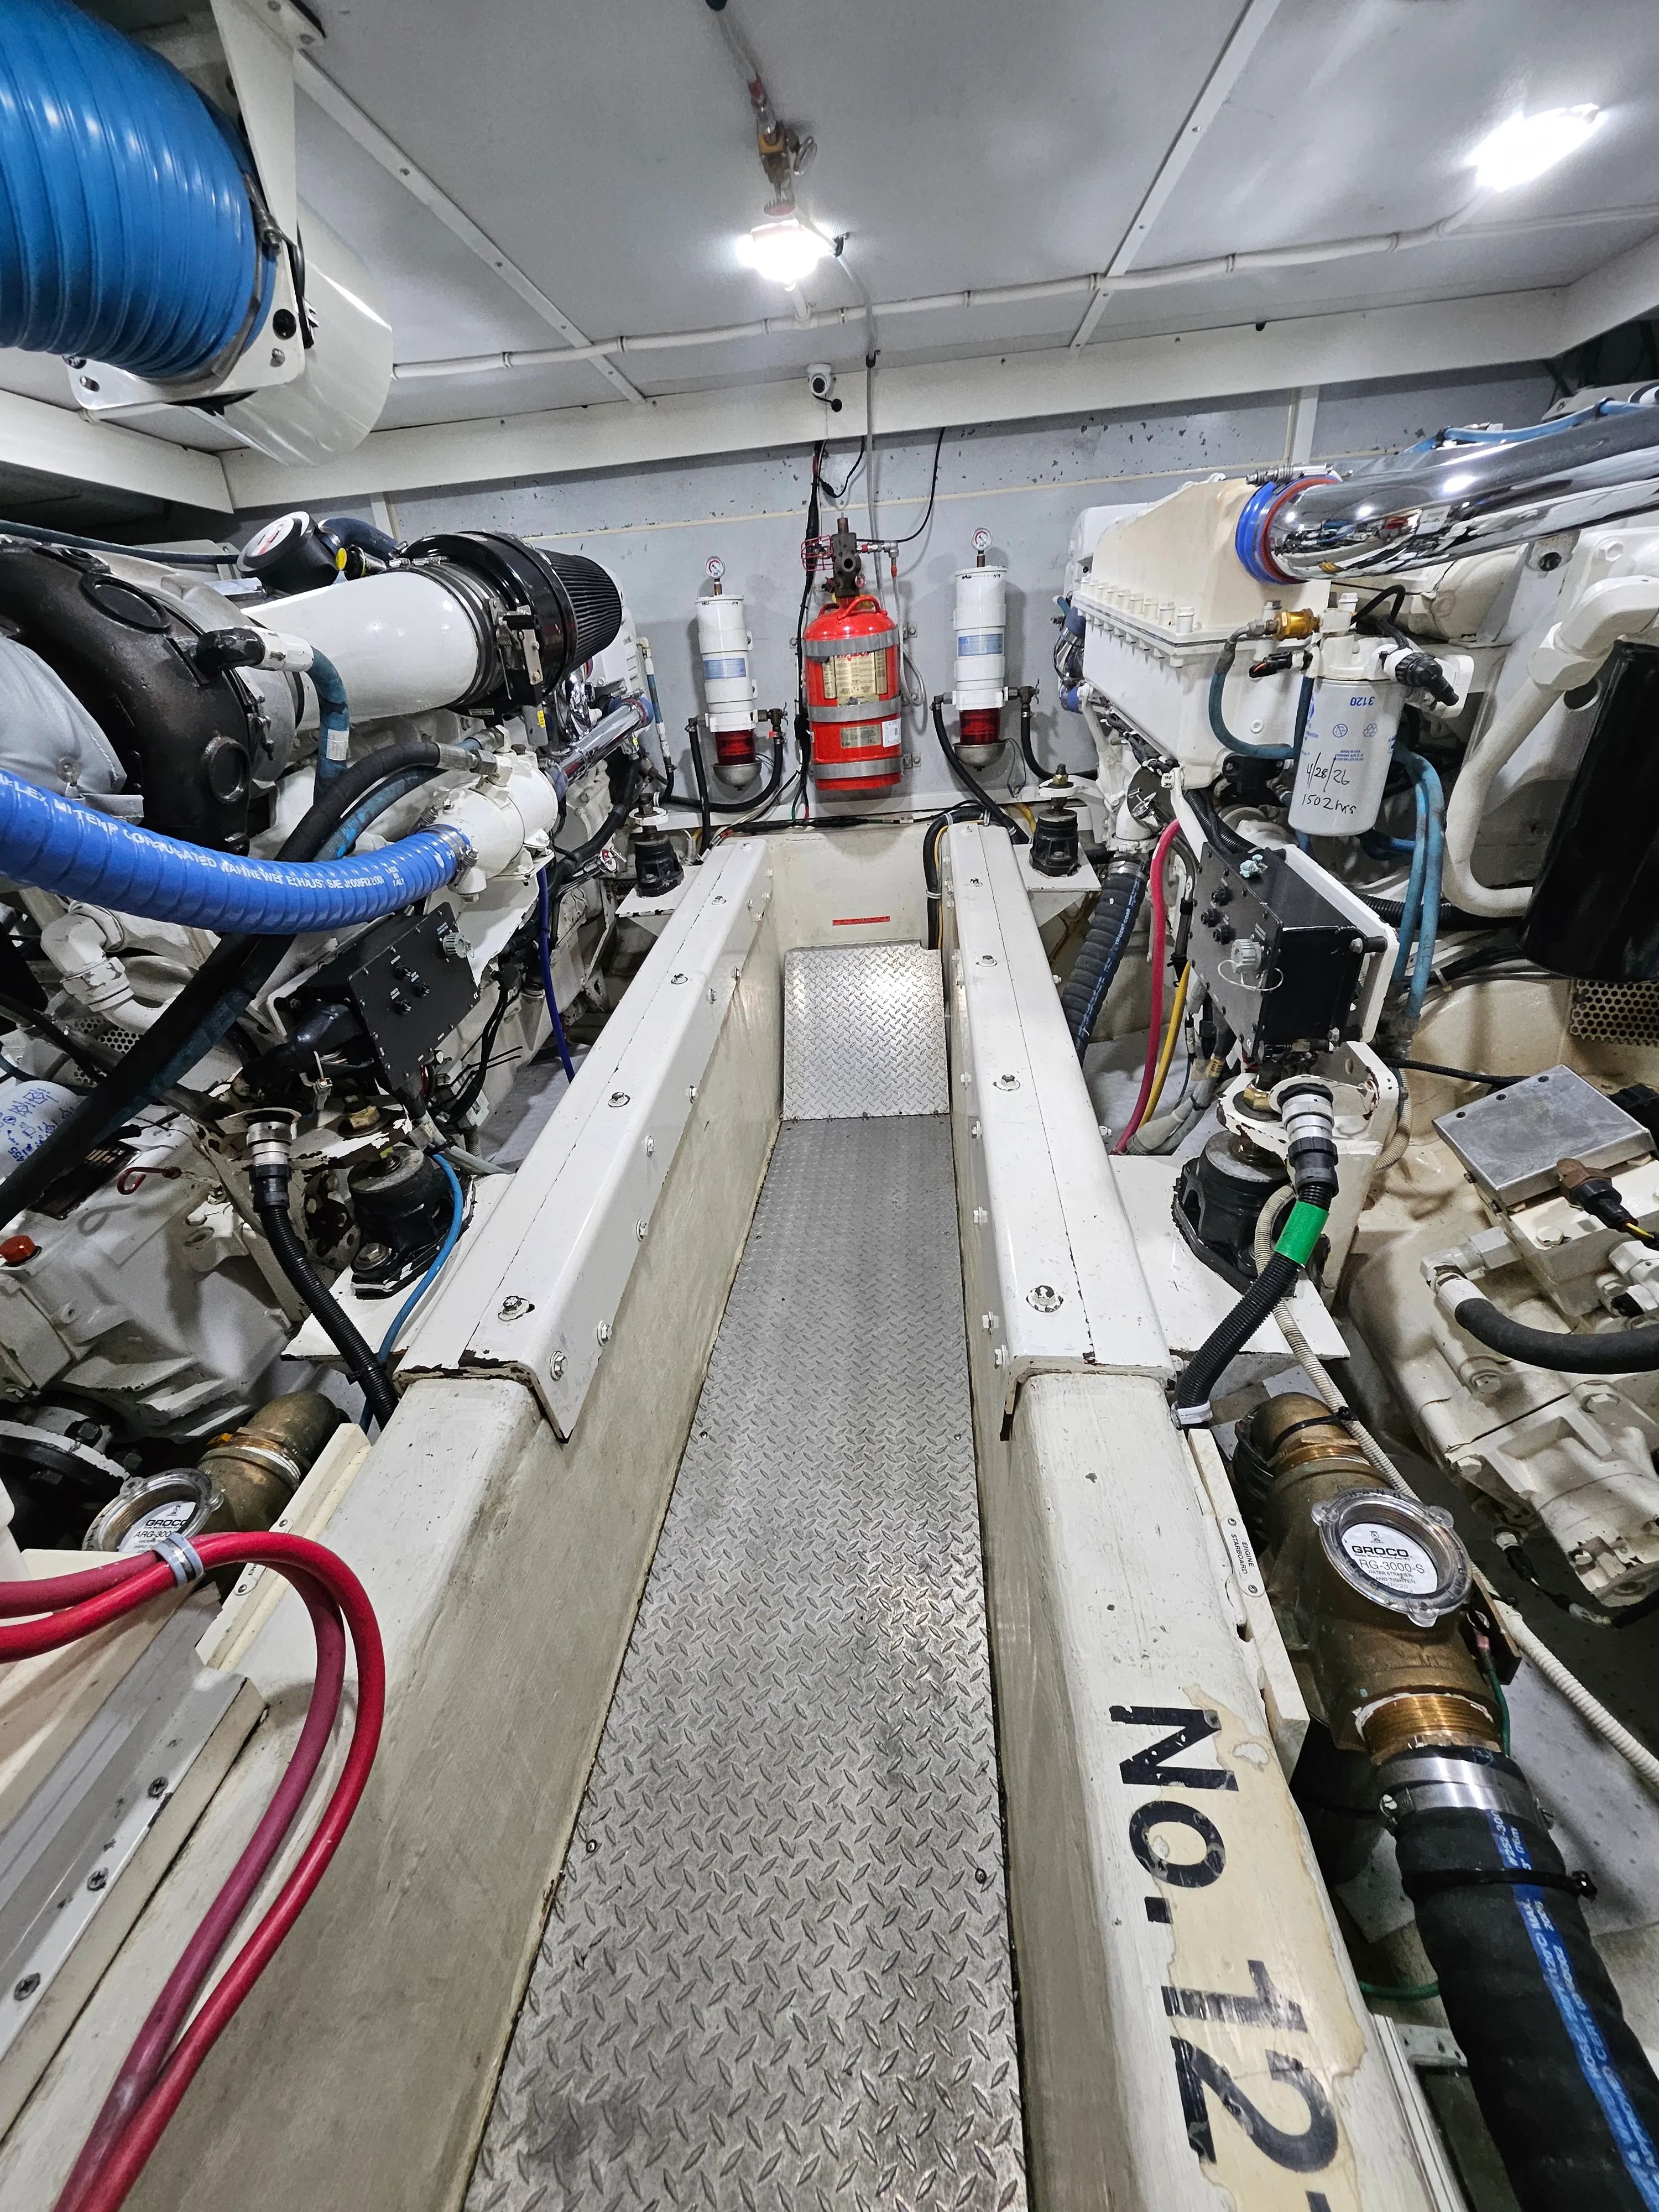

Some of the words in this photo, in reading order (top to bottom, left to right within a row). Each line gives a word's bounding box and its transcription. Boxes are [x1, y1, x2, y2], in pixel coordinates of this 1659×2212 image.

[1350, 696, 1375, 706] 3120
[1231, 1533, 1248, 1574] STARBOARD
[1241, 1542, 1255, 1568] ENGINE
[1352, 1545, 1409, 1558] GROCO
